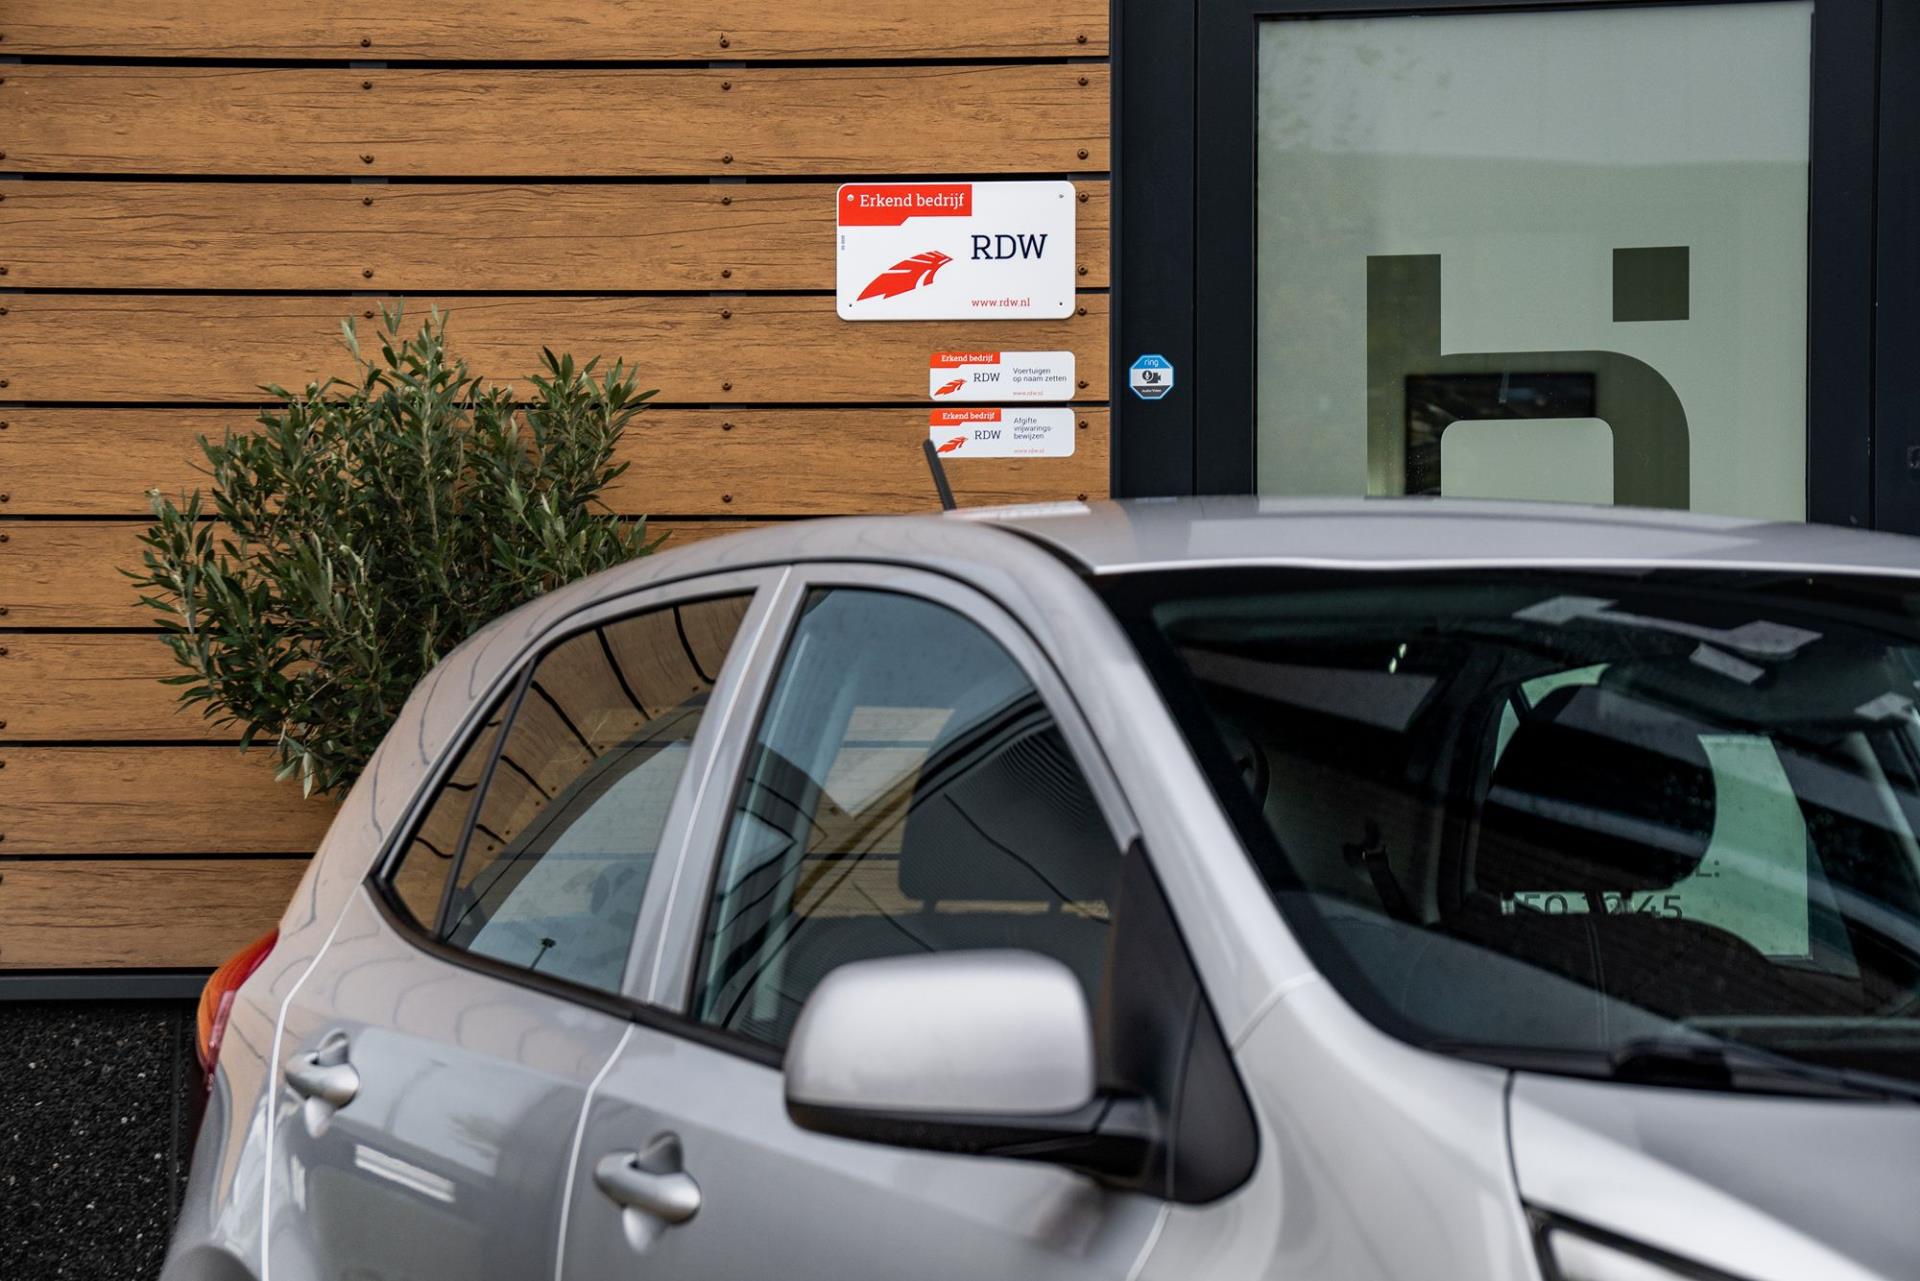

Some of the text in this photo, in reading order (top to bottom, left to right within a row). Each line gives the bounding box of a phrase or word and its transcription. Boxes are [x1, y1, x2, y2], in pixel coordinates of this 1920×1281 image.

[859, 193, 965, 209] Erkend bedrijf
[971, 234, 1048, 260] RDW
[971, 297, 1031, 308] www.rdw.nl
[941, 354, 993, 363] Erkend bedrijf
[1013, 367, 1051, 376] Voertuigen
[973, 372, 1001, 383] RDW
[942, 411, 995, 421] Erkend bedrijf
[1013, 417, 1037, 426] Afgifte
[974, 430, 1002, 440] RDW
[1013, 432, 1045, 441] bewijzen
